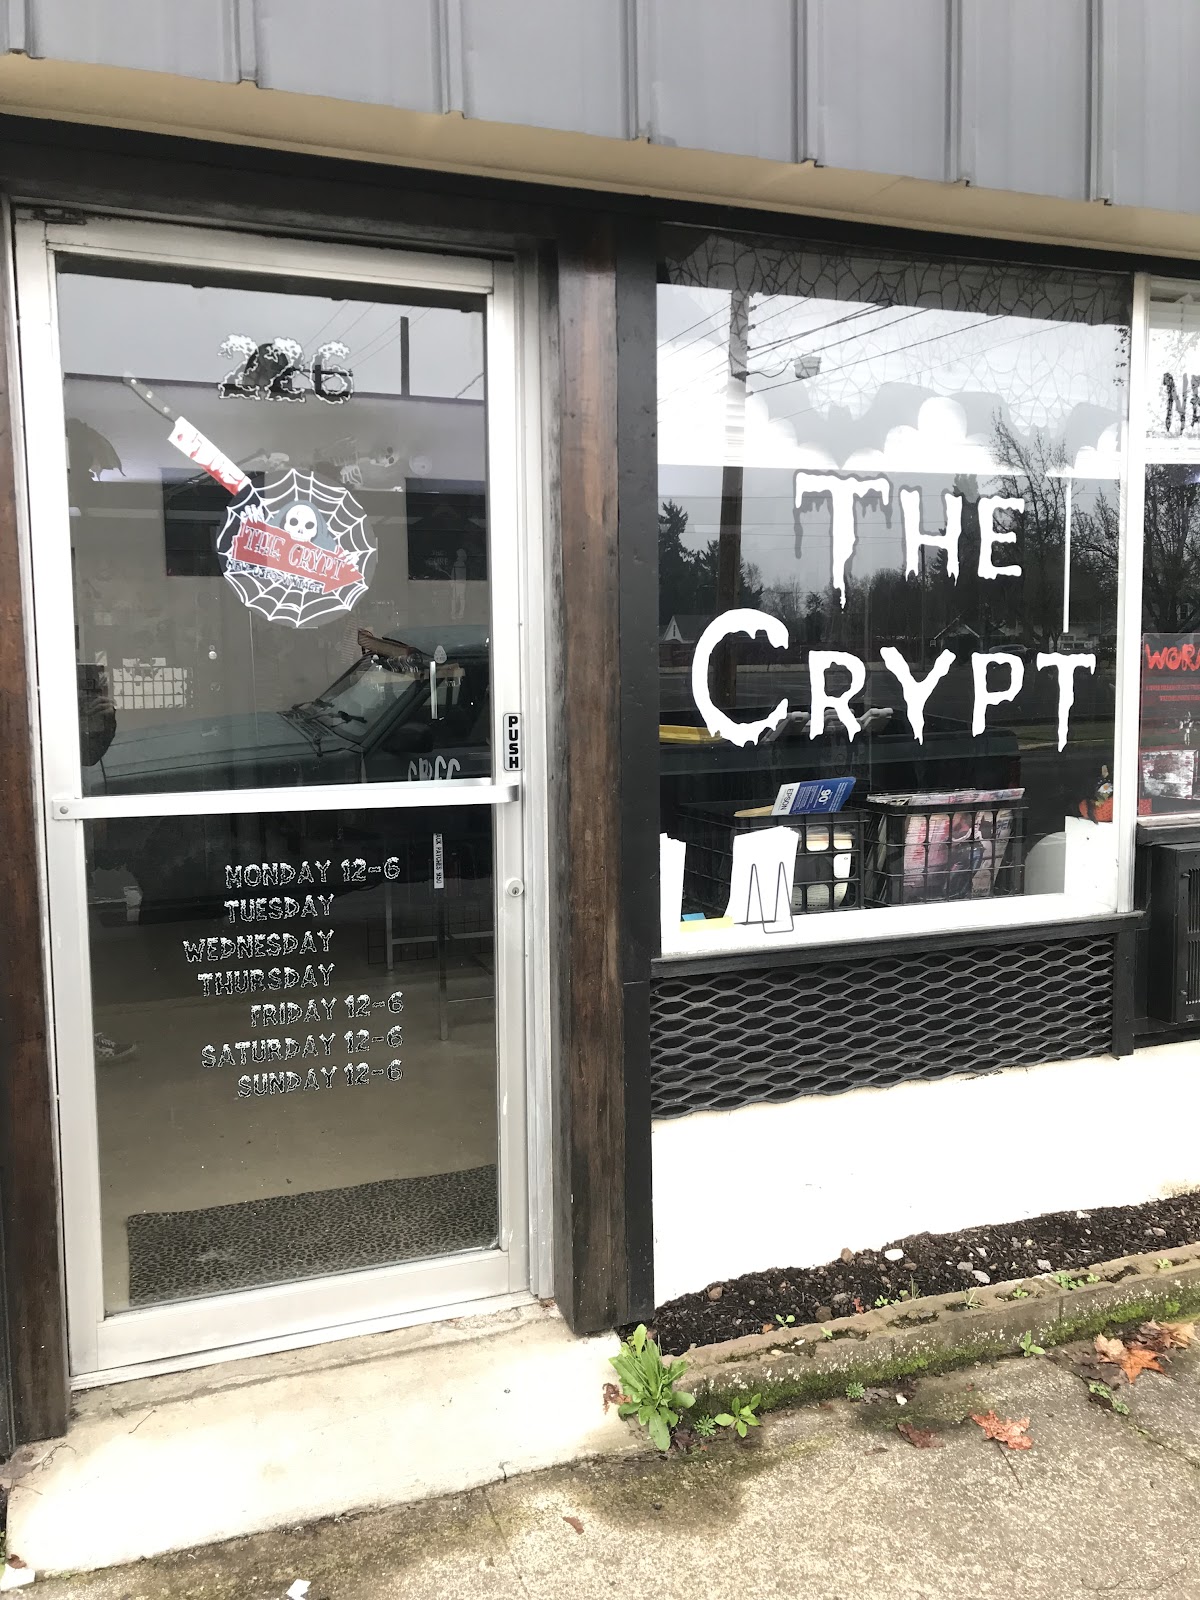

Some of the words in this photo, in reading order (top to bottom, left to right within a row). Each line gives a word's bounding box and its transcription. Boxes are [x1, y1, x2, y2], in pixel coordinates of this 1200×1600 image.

[217, 334, 354, 405] 226
[242, 525, 286, 562] THE
[288, 543, 348, 581] CRYPT
[793, 470, 1025, 610] THE
[691, 607, 1096, 753] CRYPT
[508, 715, 519, 769] PUSH
[780, 788, 794, 811] EPSON
[224, 859, 332, 889] MONDAY
[340, 856, 401, 882] 12-6
[224, 893, 335, 924] TUESDAY
[182, 929, 335, 963] WEDNESDAY
[197, 962, 336, 998] THURSDAY
[250, 997, 338, 1028] FRIDAY
[344, 991, 404, 1018] 12-6
[201, 1032, 336, 1068] SATURDAY
[343, 1025, 404, 1053] 12-6
[236, 1065, 338, 1098] SUNDAY
[343, 1058, 404, 1086] 12-6
